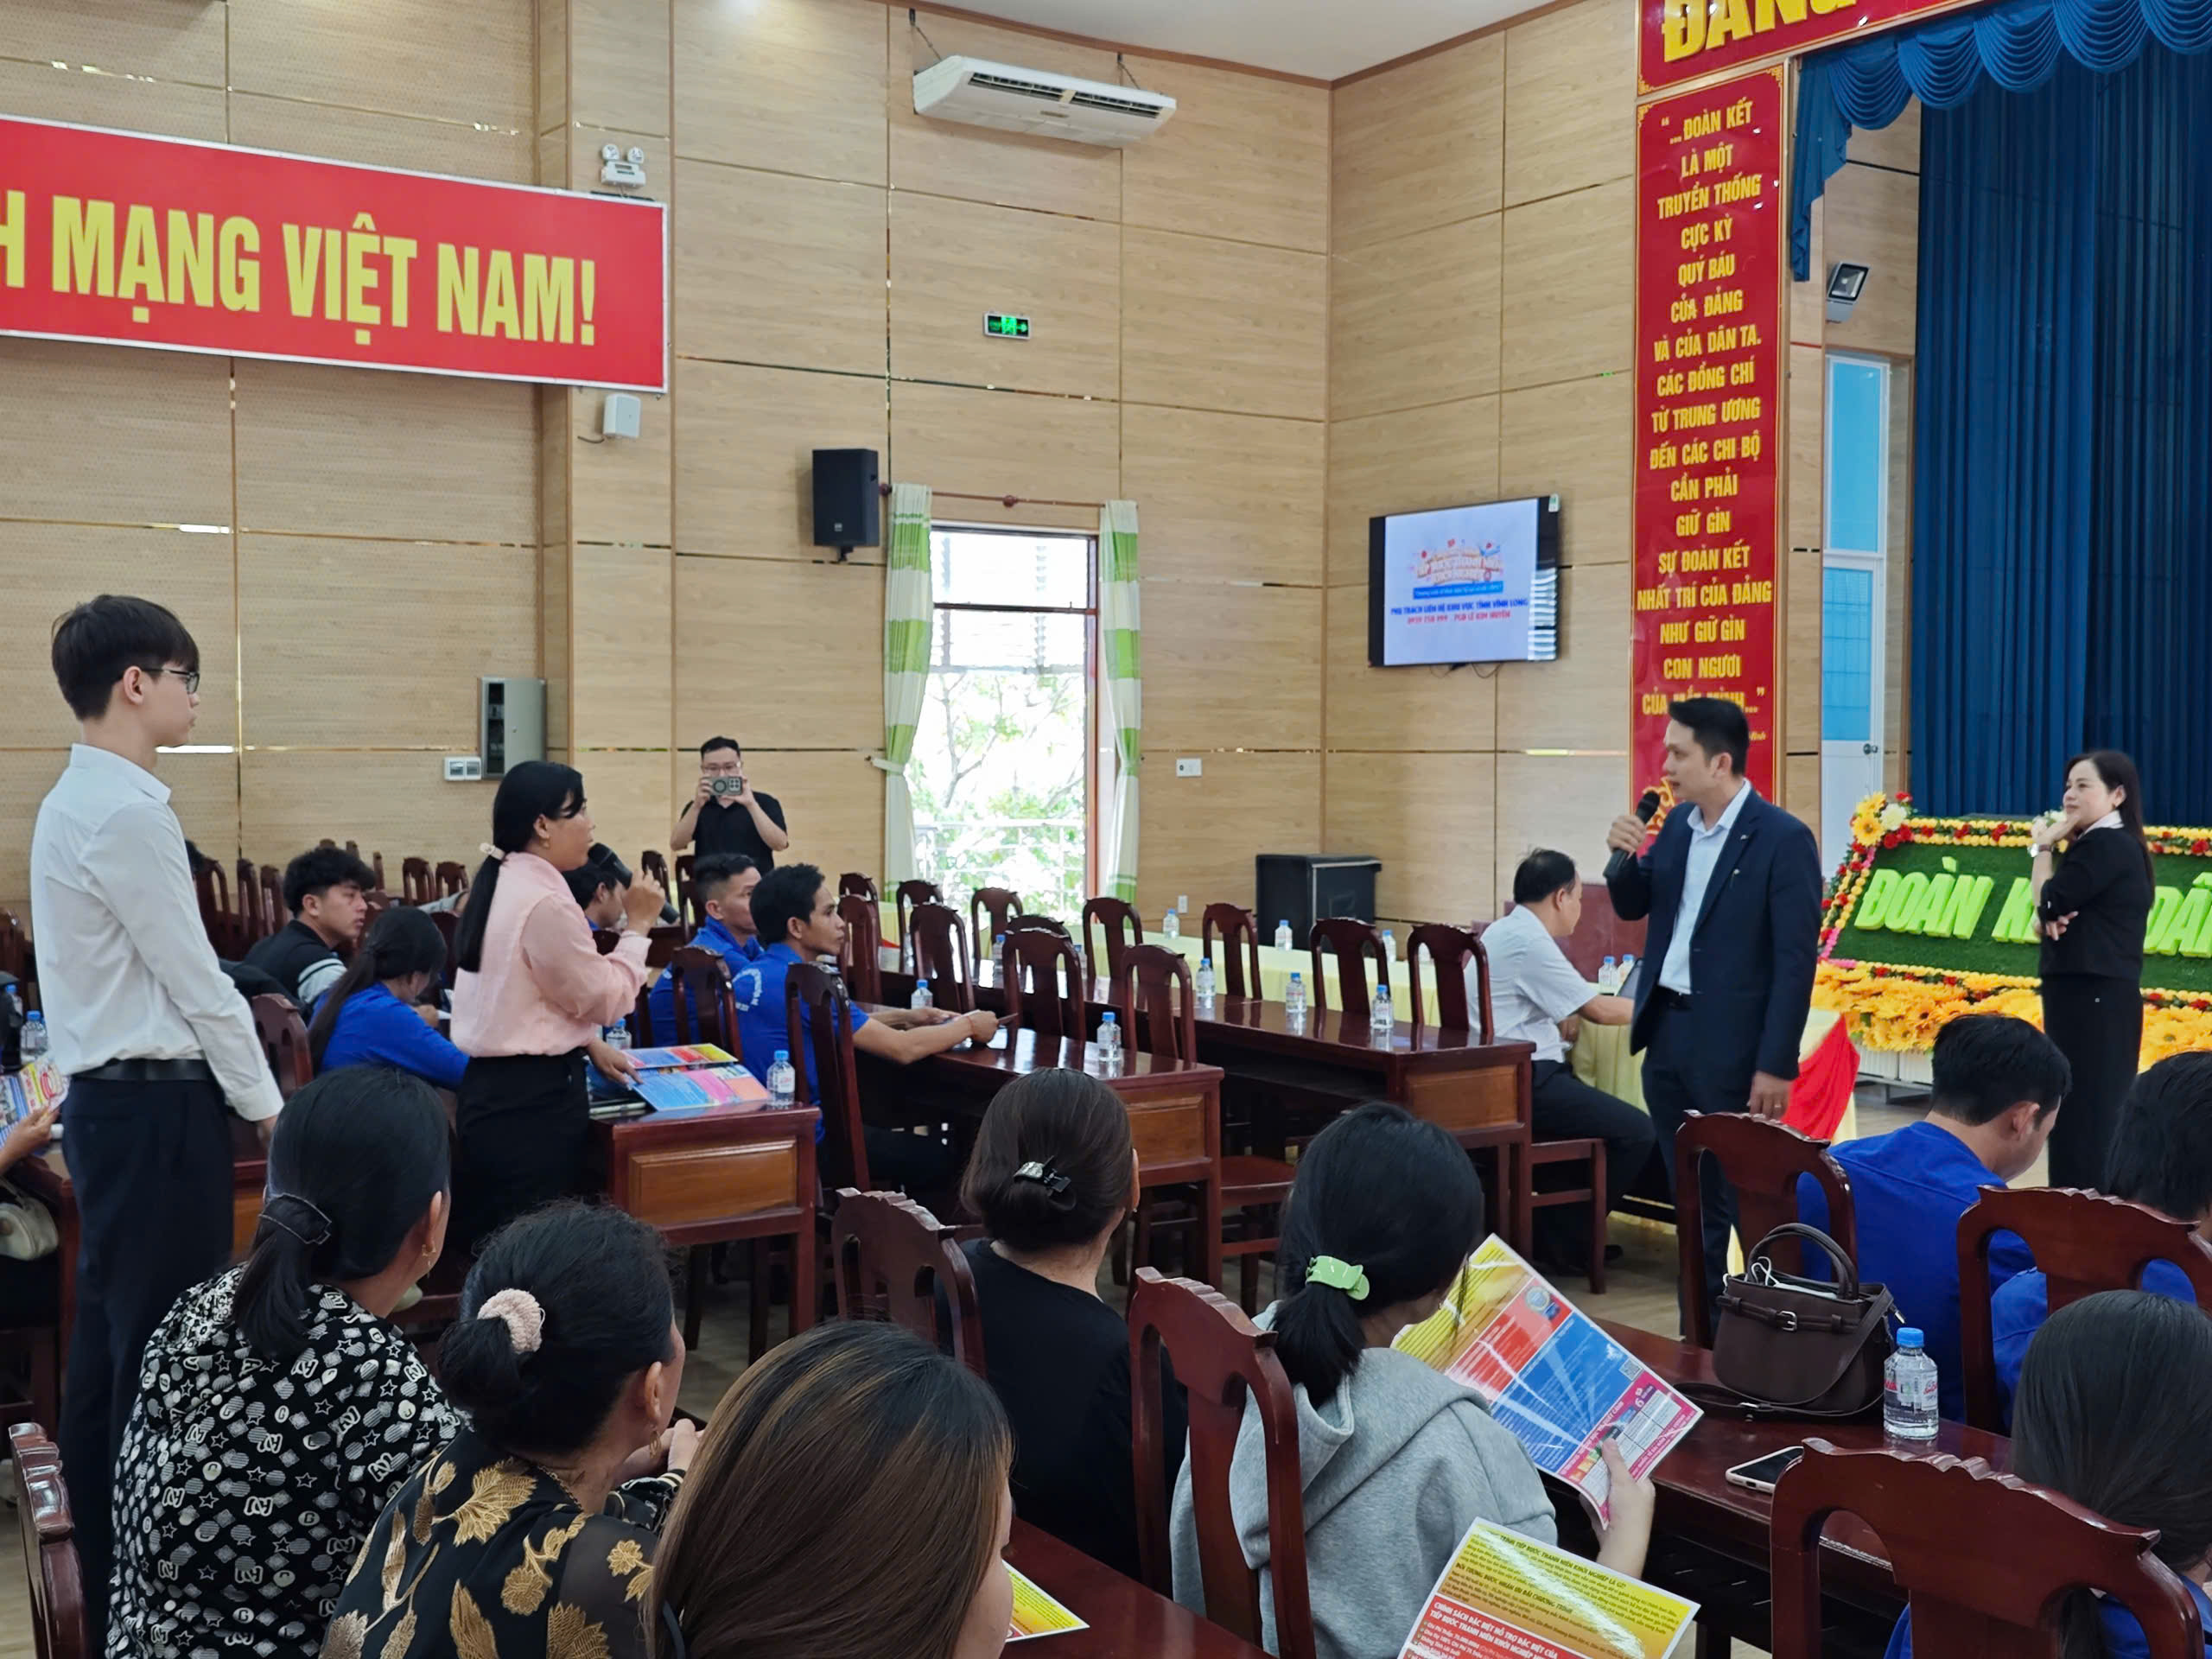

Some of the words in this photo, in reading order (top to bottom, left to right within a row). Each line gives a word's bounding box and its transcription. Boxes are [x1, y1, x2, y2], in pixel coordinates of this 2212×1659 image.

[1726, 97, 1752, 128] KẾT
[1681, 149, 1700, 177] LÀ
[1704, 143, 1733, 173] MỘT
[1713, 172, 1762, 205] THỐNG
[53, 195, 260, 323] MẠNG
[283, 213, 416, 345] VIỆT
[437, 244, 595, 346] NAM!
[1678, 254, 1705, 287] QUÝ
[1708, 251, 1735, 280] BÁU
[1671, 294, 1697, 323] CỦA
[1704, 286, 1743, 316] ĐẢNG
[1655, 334, 1670, 362] VÀ
[1675, 327, 1702, 359] CỦA
[1707, 322, 1737, 353] DÂN
[1739, 325, 1761, 346] TA.
[1657, 368, 1684, 397] CÁC
[1688, 360, 1726, 391] ĐỒNG
[1731, 354, 1754, 385] CHÍ
[1673, 404, 1717, 429] TRUNG
[1721, 397, 1761, 422] ƯƠNG
[1650, 441, 1676, 469] ĐẾN
[1682, 437, 1708, 465] CÁC
[1713, 437, 1737, 461] CHI
[1741, 429, 1760, 461] BỘ
[1671, 472, 1700, 501] CẦN
[1705, 467, 1738, 498] PHẢI
[1707, 505, 1731, 534] GÌN
[1681, 543, 1719, 572] ĐOÀN
[1723, 539, 1750, 569] KẾT
[1637, 583, 1672, 610] NHẤT
[1675, 582, 1697, 608] TRÍ
[1700, 577, 1728, 607] CỦA
[1732, 574, 1772, 604] ĐẢNG
[1660, 620, 1689, 643] NHƯ
[1720, 614, 1745, 641] GÌN
[1663, 658, 1693, 679] CON
[1642, 687, 1669, 715] CỦA
[1854, 856, 1994, 939] ĐOÀN
